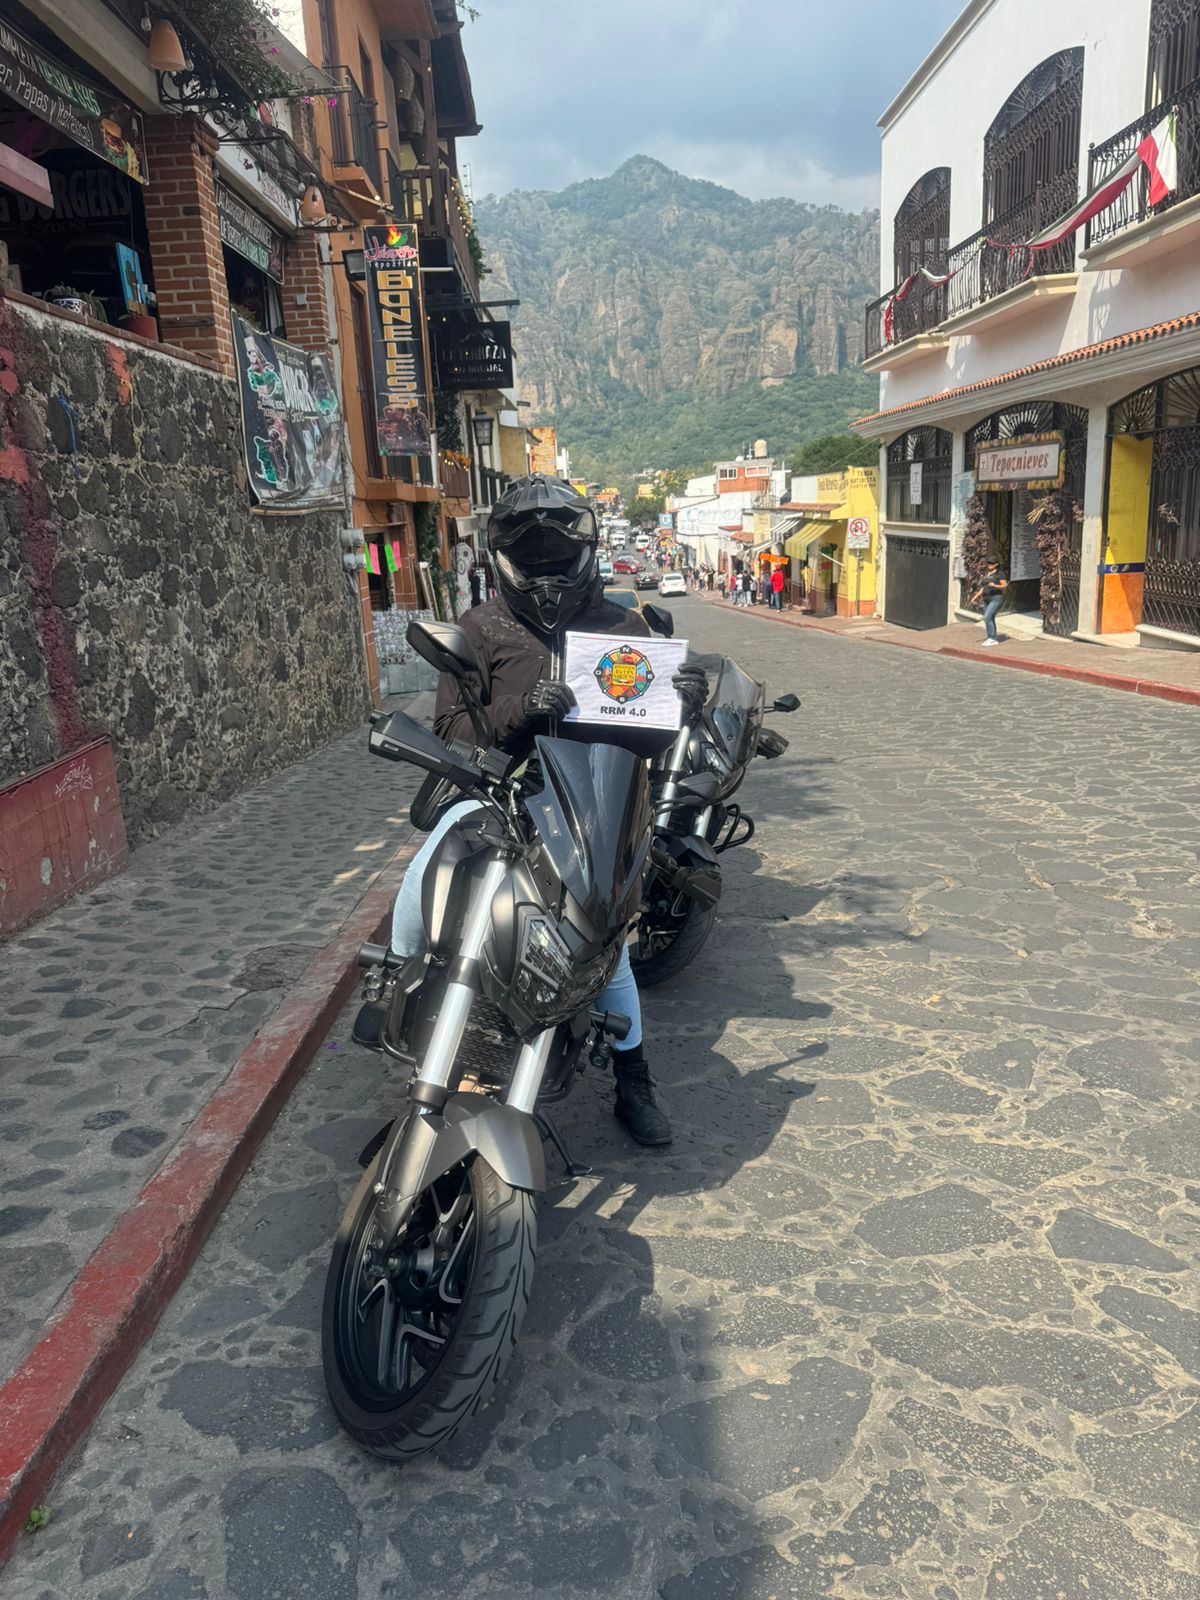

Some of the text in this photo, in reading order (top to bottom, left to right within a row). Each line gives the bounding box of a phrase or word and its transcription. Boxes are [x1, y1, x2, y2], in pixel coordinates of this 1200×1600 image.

[16, 67, 49, 112] Papas
[49, 100, 57, 122] y
[17, 169, 131, 221] BRGERS
[377, 270, 419, 408] BONELESS
[991, 450, 1049, 477] Tepoznieves
[600, 706, 646, 717] RRM 4.0
